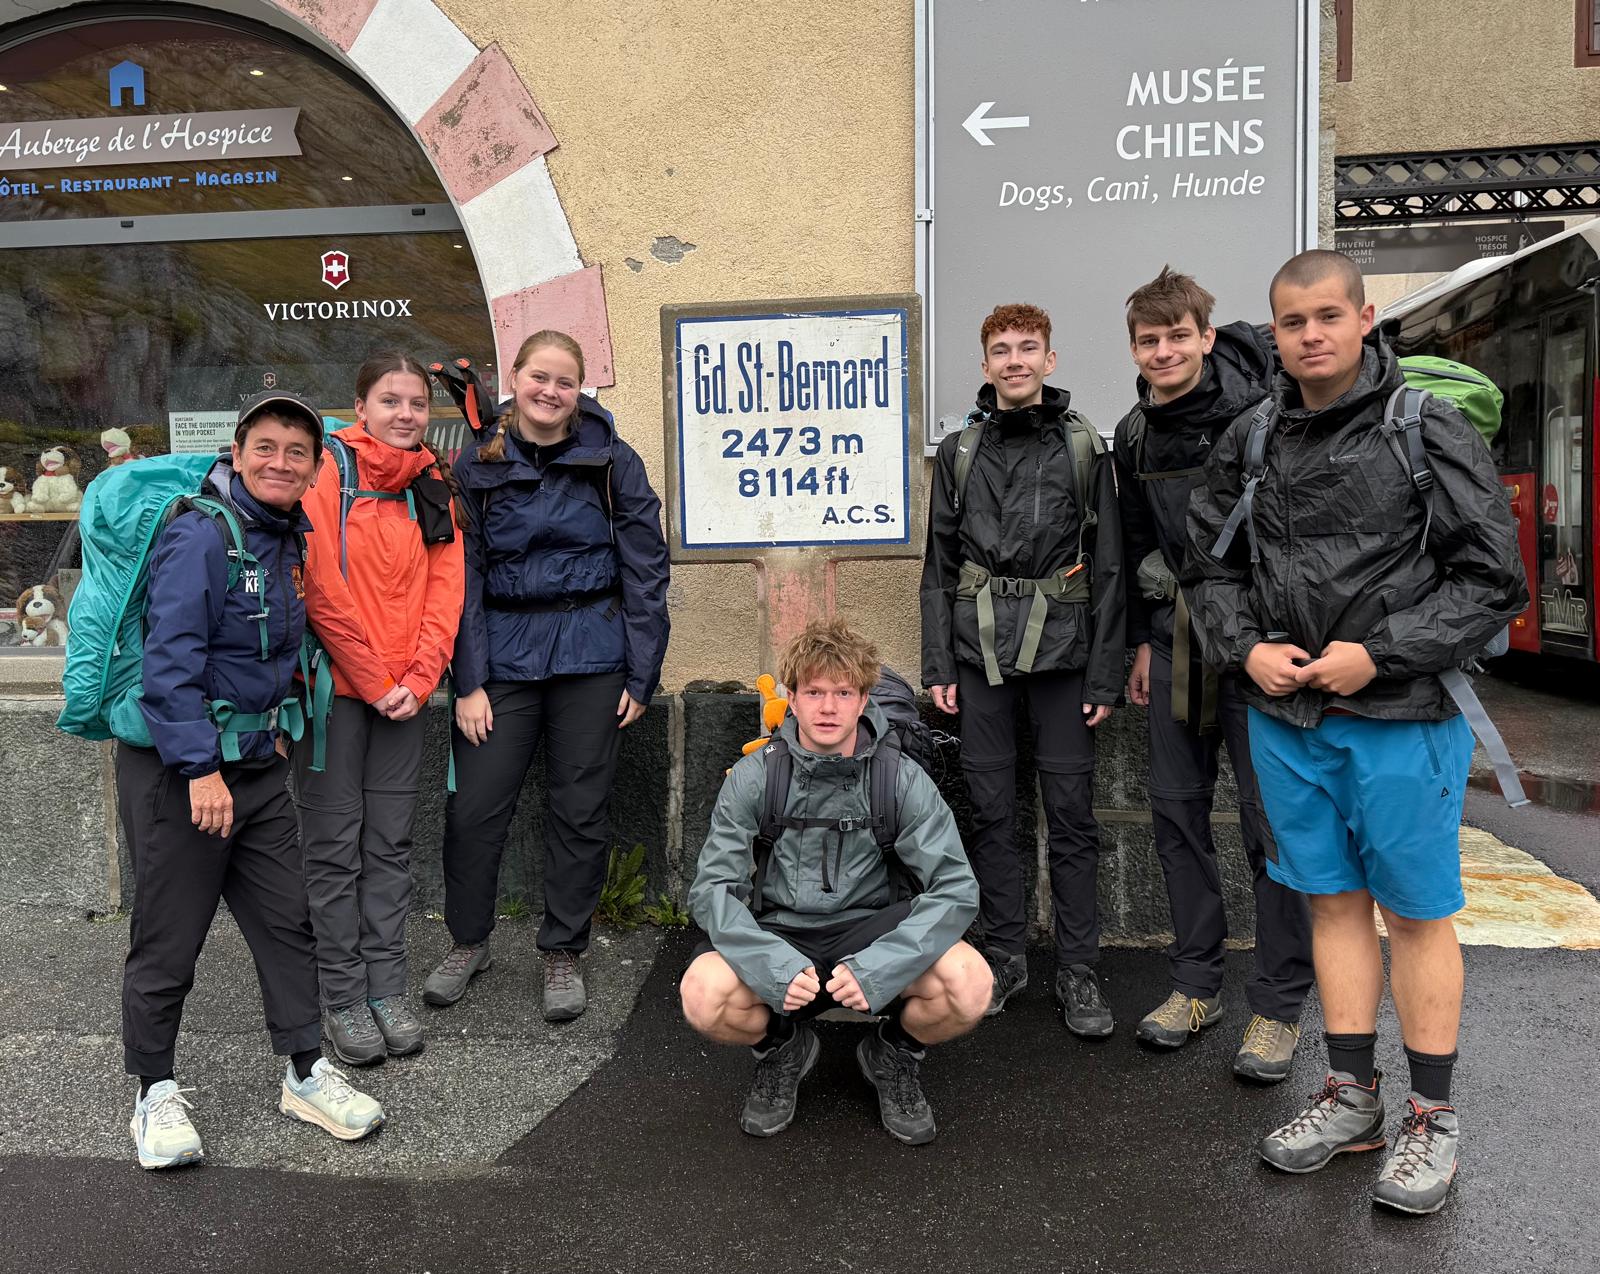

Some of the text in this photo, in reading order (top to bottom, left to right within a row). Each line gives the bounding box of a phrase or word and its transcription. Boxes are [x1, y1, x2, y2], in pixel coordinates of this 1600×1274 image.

[1126, 58, 1265, 106] MUSÉE
[0, 127, 101, 163] Auberge
[108, 126, 136, 152] de
[1116, 119, 1265, 160] CHIENS
[0, 176, 39, 196] ÔTEL
[999, 169, 1265, 212] Dogs, Cani, Hunde
[1335, 240, 1376, 249] ENVENUE
[1475, 234, 1508, 243] HOSPICE
[264, 299, 412, 320] VICTORINOX
[180, 429, 195, 437] YOUR
[199, 421, 225, 429] OUTDOORS
[721, 426, 864, 458] 2473 m
[821, 504, 896, 525] A.C.S.
